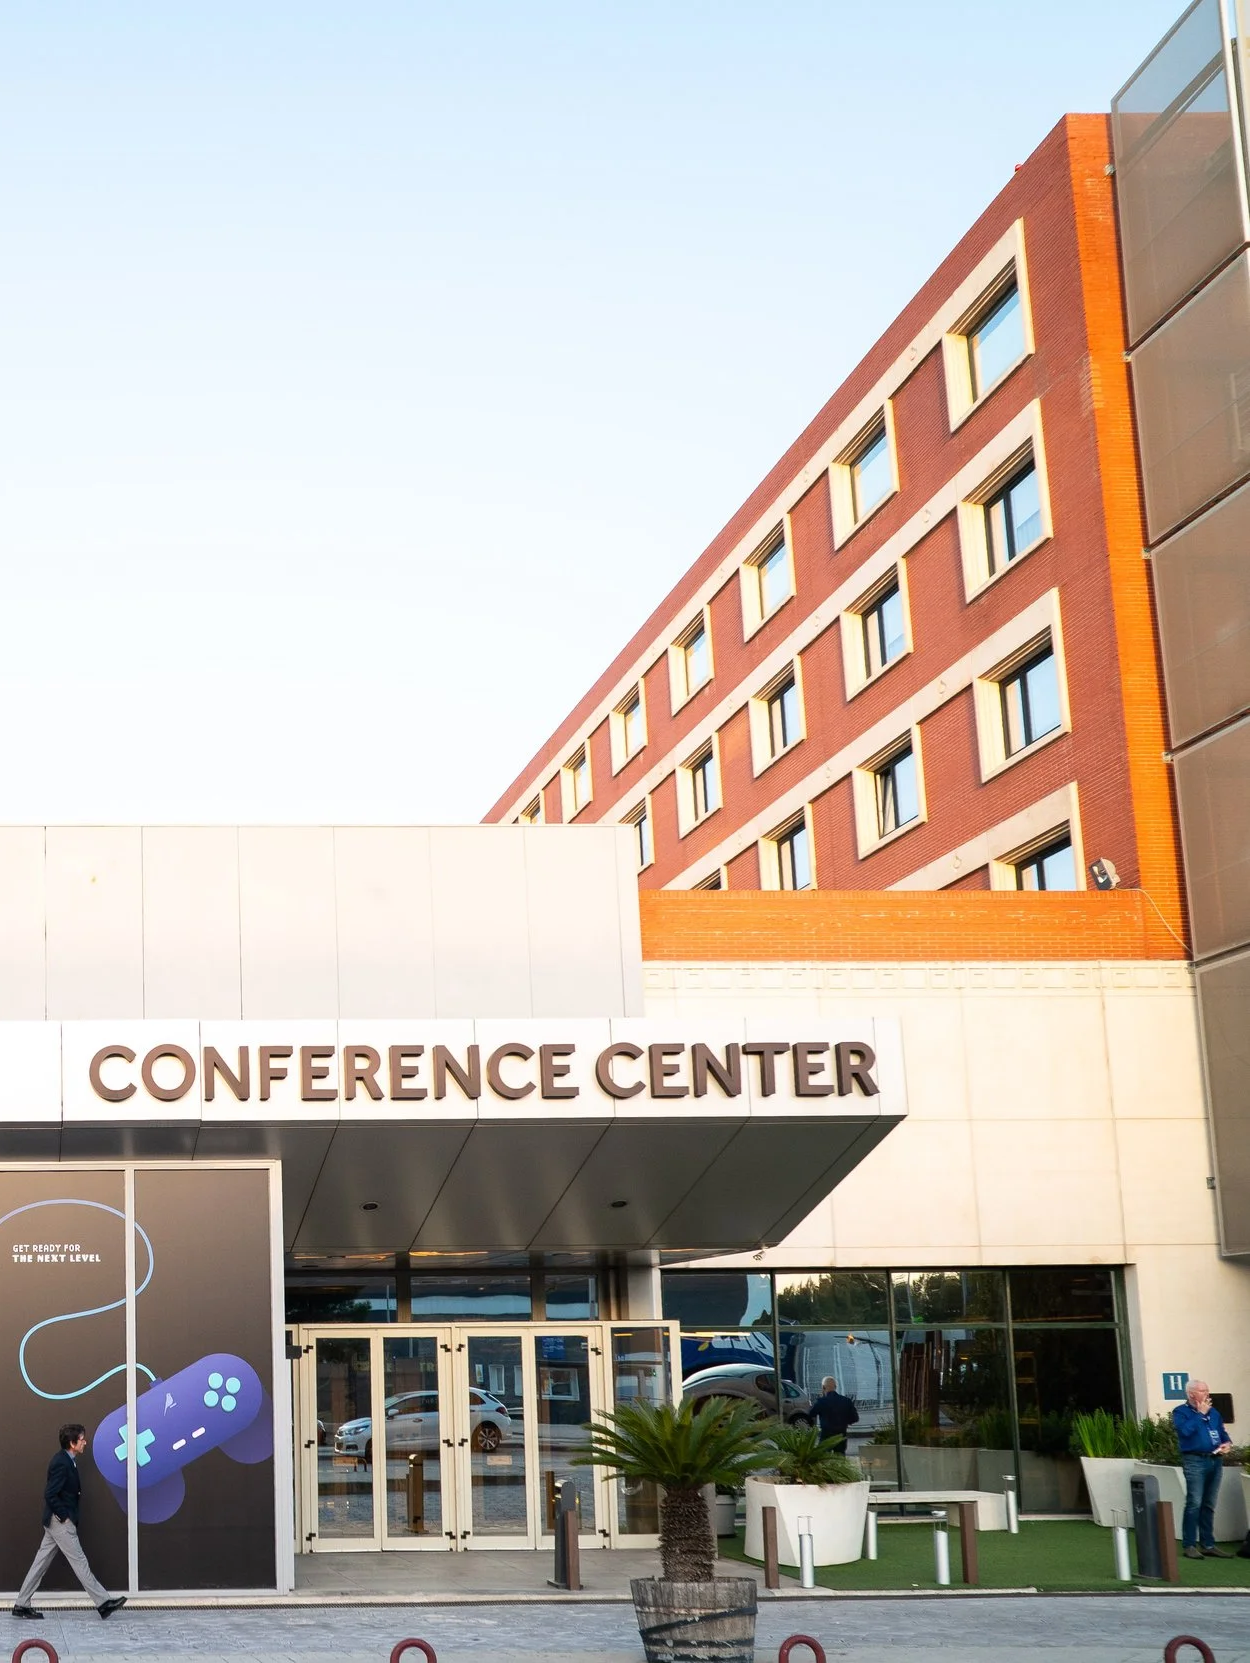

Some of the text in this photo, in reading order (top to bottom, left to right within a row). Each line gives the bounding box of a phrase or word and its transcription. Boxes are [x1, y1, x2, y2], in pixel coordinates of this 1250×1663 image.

[89, 1041, 880, 1101] CONFERENCE CENTER
[12, 1243, 81, 1253] GET READY FOR
[12, 1253, 101, 1263] THE NEXT LEVEL
[1169, 1375, 1182, 1390] H
